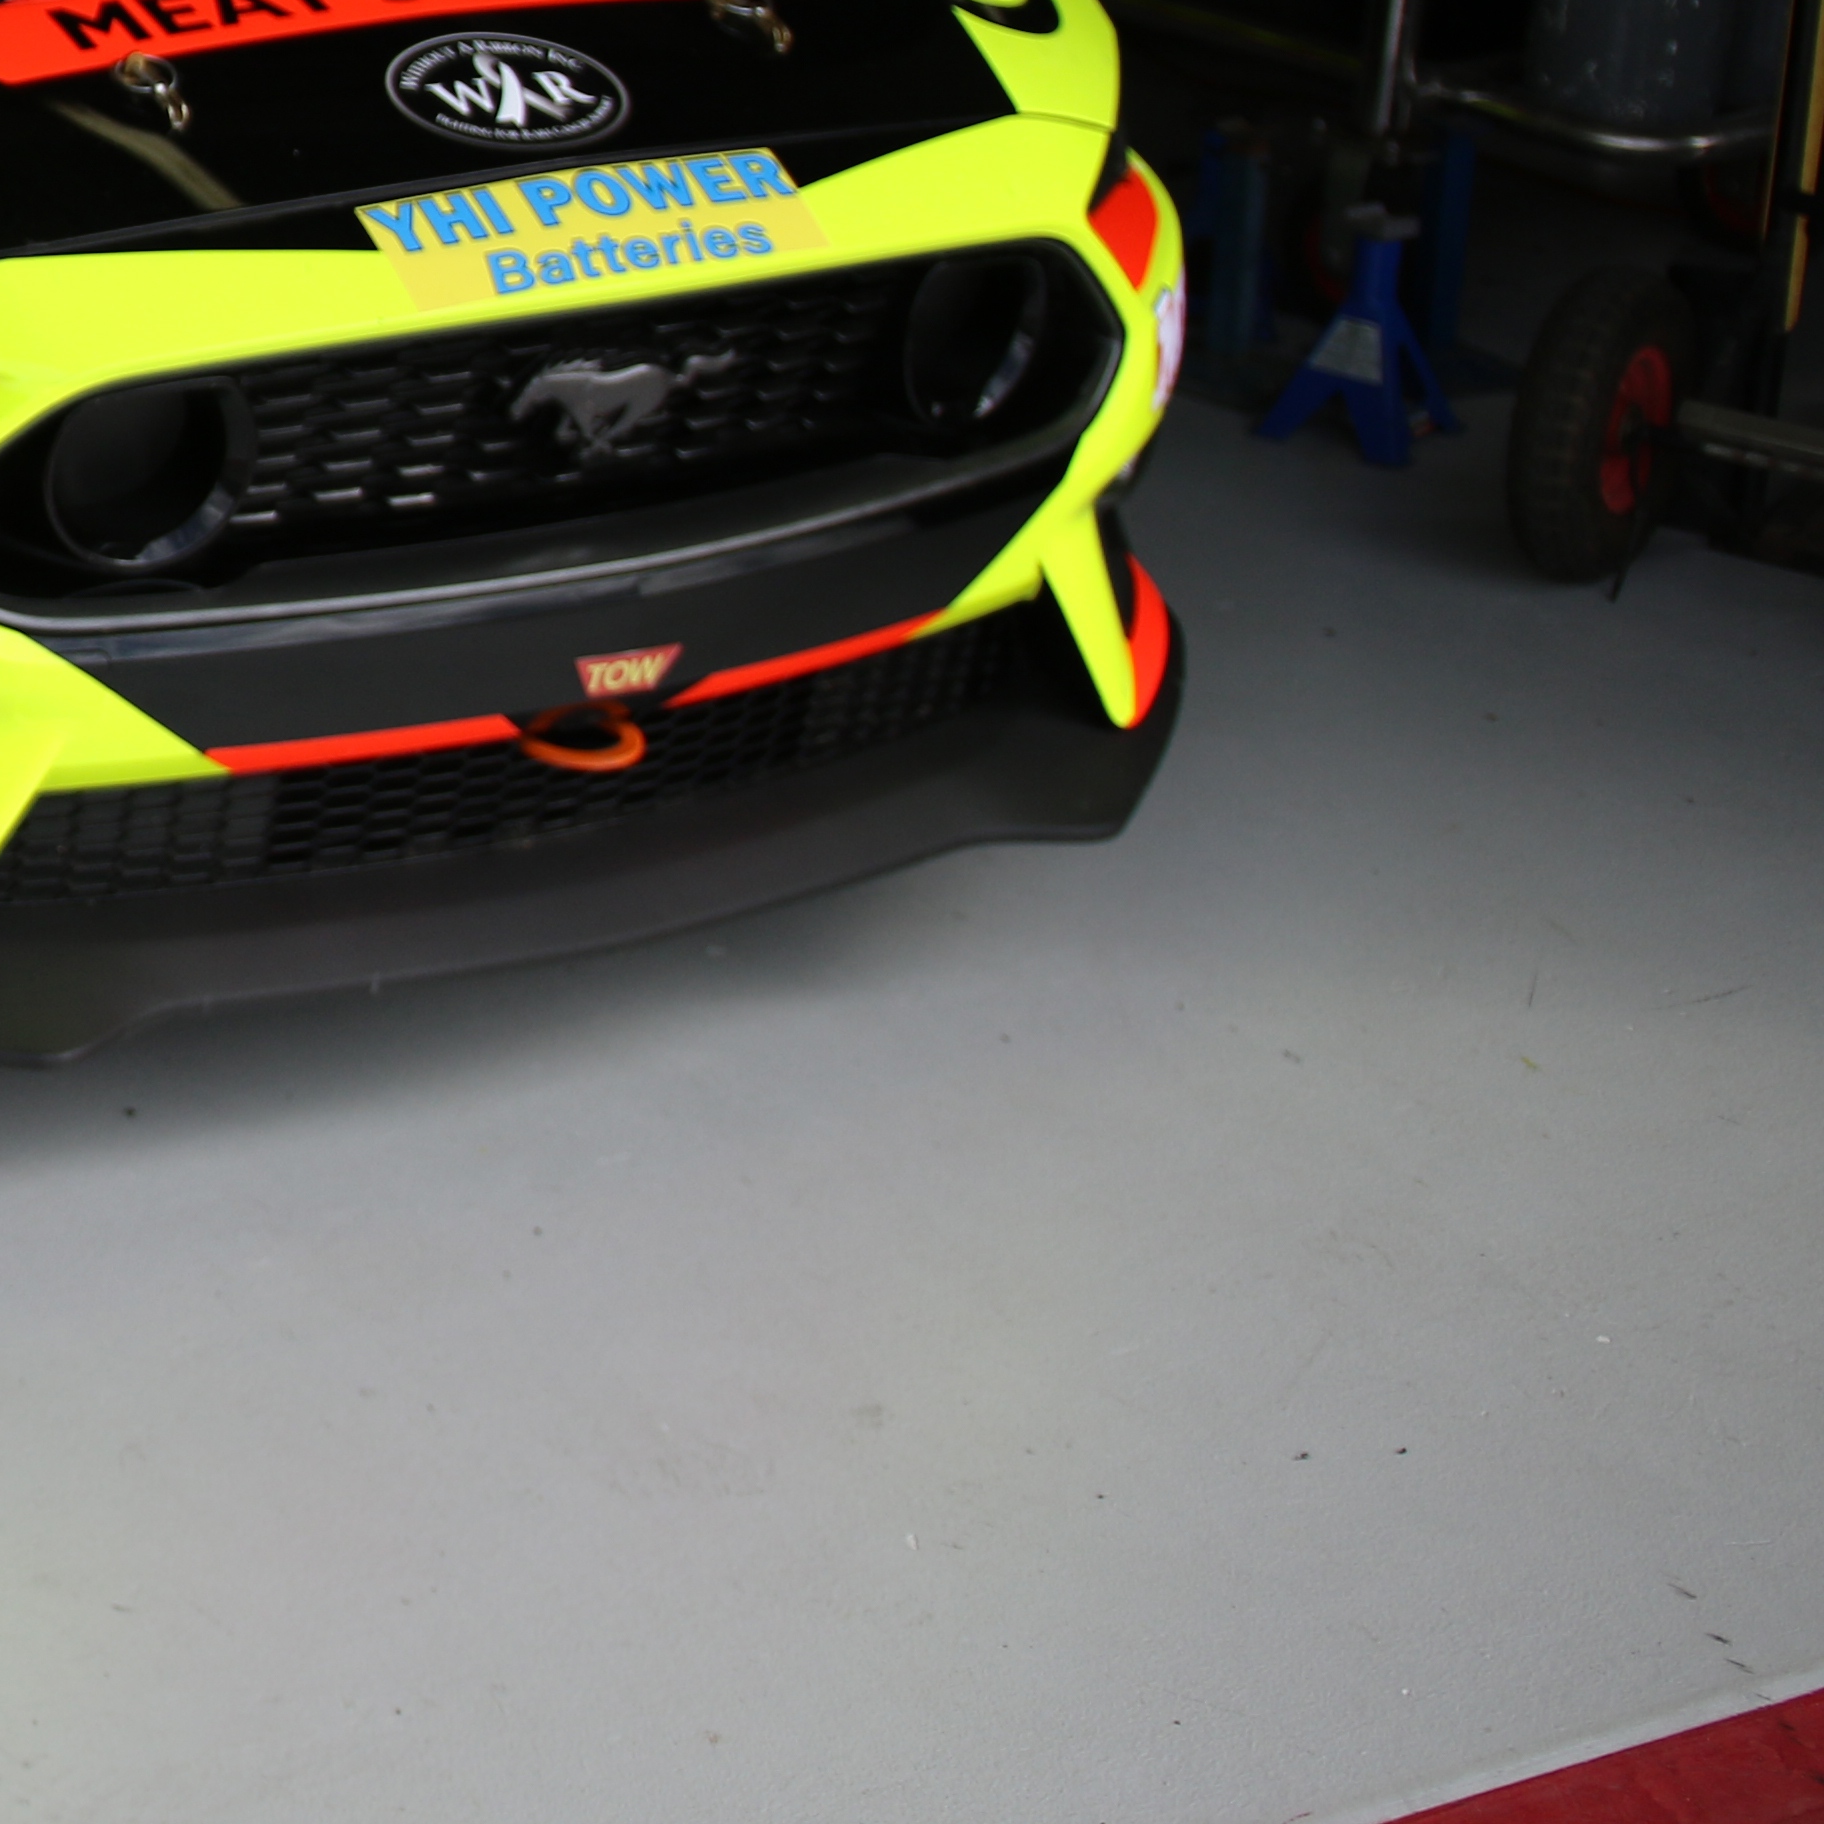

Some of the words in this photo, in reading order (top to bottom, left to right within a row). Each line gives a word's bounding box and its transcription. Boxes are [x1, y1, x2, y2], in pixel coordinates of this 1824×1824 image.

[363, 191, 516, 253] YHI
[515, 153, 799, 227] POWER
[485, 220, 774, 296] Batteries
[586, 653, 666, 693] TOW
